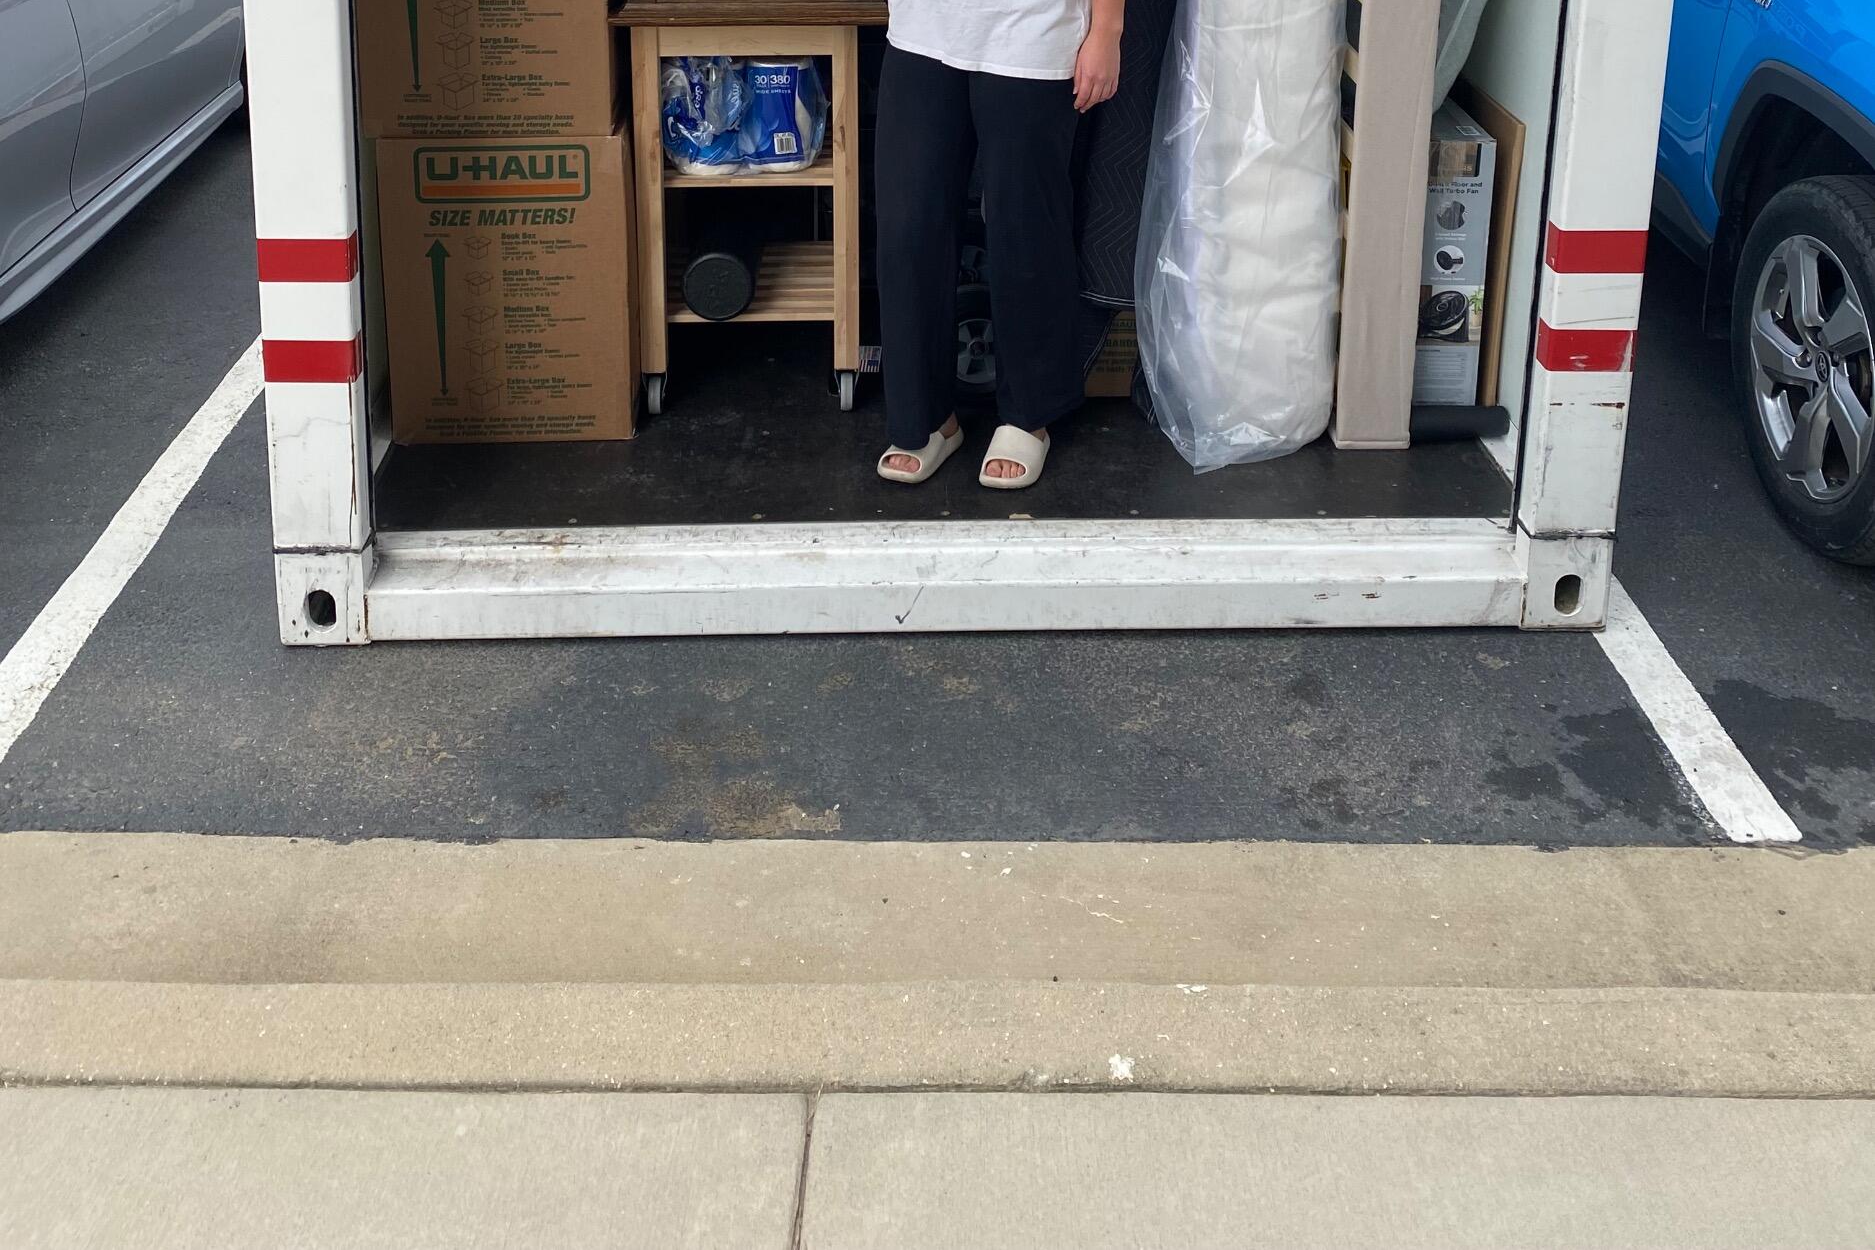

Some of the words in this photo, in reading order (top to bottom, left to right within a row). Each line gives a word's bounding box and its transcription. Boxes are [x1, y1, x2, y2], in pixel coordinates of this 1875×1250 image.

[480, 37, 501, 45] Large
[503, 37, 518, 45] Box
[482, 74, 526, 82] Extra-Large
[528, 74, 543, 82] Box
[754, 74, 767, 84] 30
[770, 74, 791, 84] 380
[425, 154, 579, 182] U-HAUL
[428, 208, 472, 227] SIZE
[476, 208, 576, 227] MATTERS!
[504, 342, 526, 350] Large
[528, 342, 542, 350] Box
